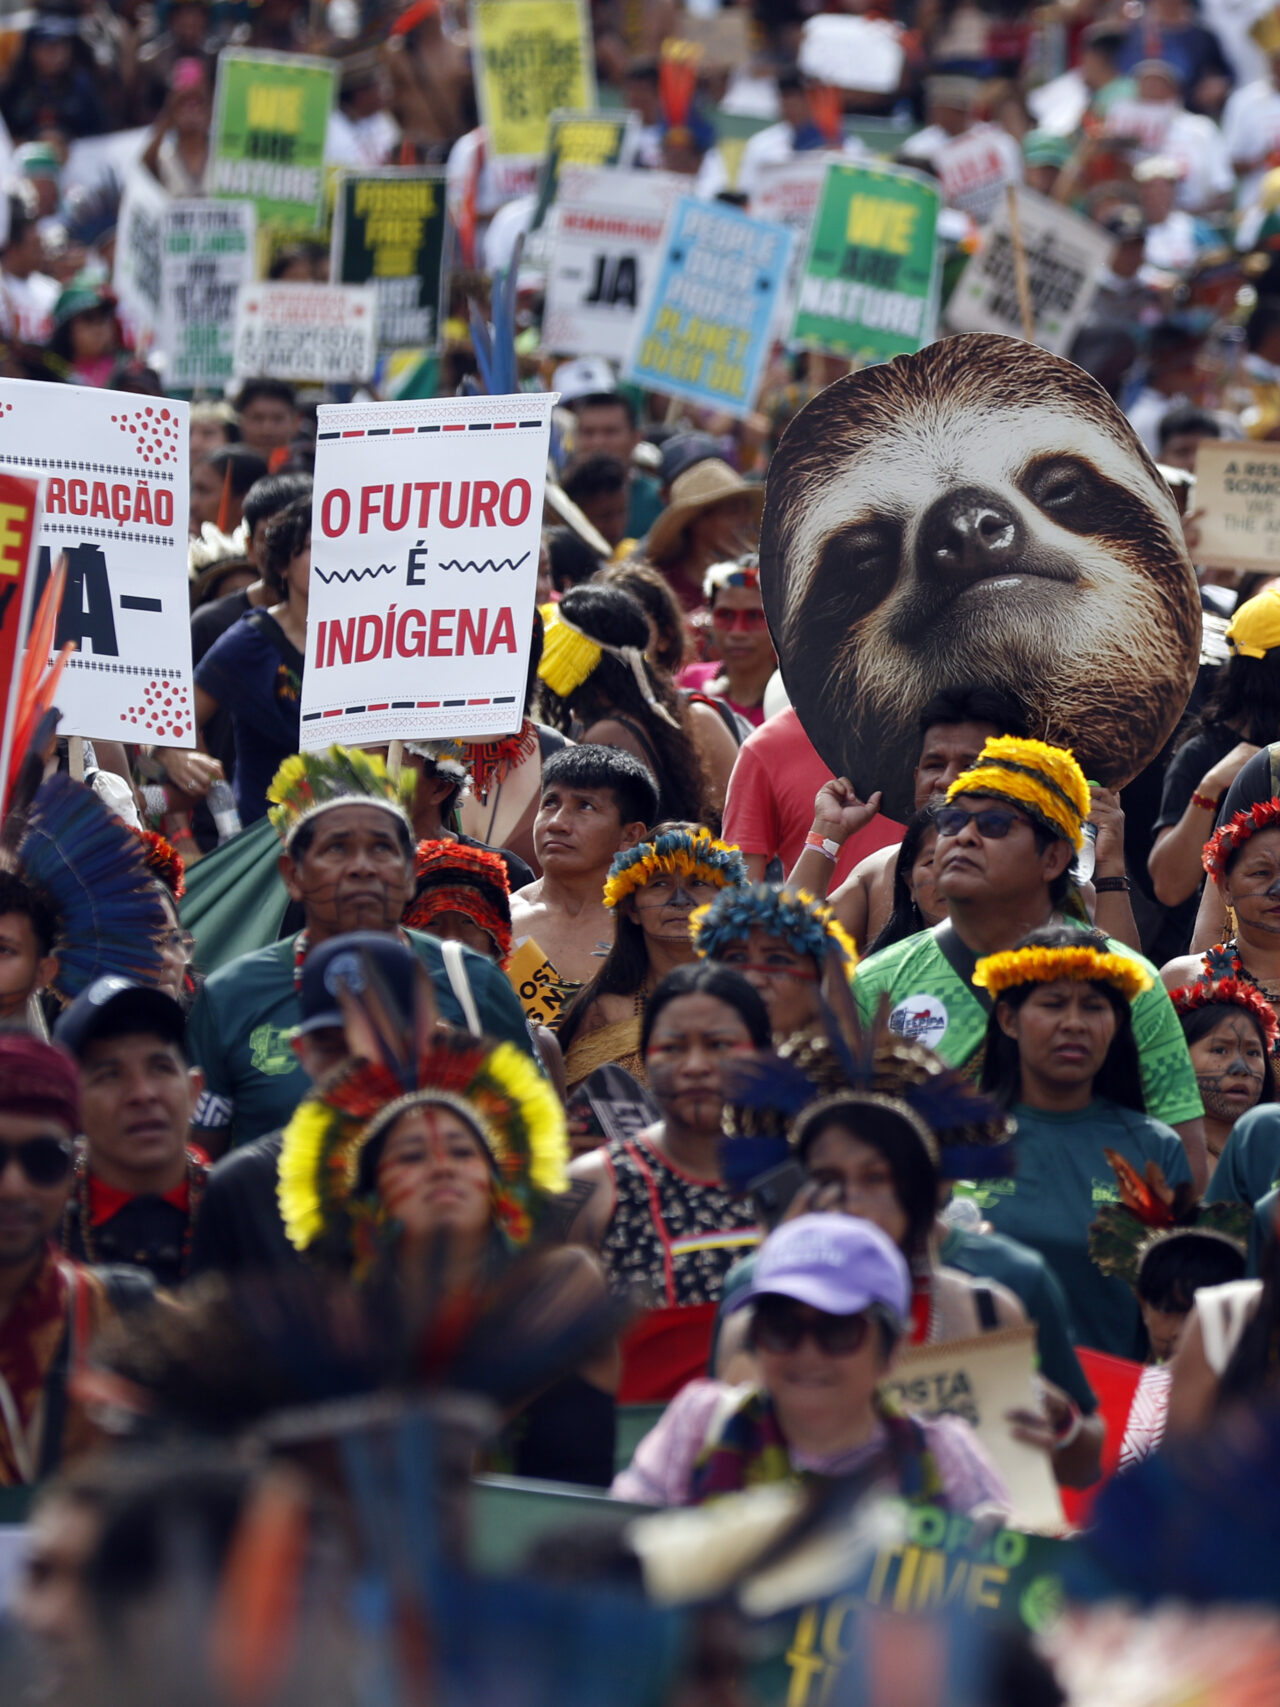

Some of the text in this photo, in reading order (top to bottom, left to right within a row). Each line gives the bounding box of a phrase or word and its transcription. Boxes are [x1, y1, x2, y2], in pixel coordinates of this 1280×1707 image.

[846, 192, 920, 255] WE
[799, 276, 926, 338] NATURE
[1224, 461, 1239, 475] A
[42, 477, 174, 527] RCAÇÃO
[321, 477, 532, 538] O FUTURO
[1224, 514, 1256, 533] THE
[405, 539, 428, 586] É
[315, 602, 517, 669] INDÍGENA
